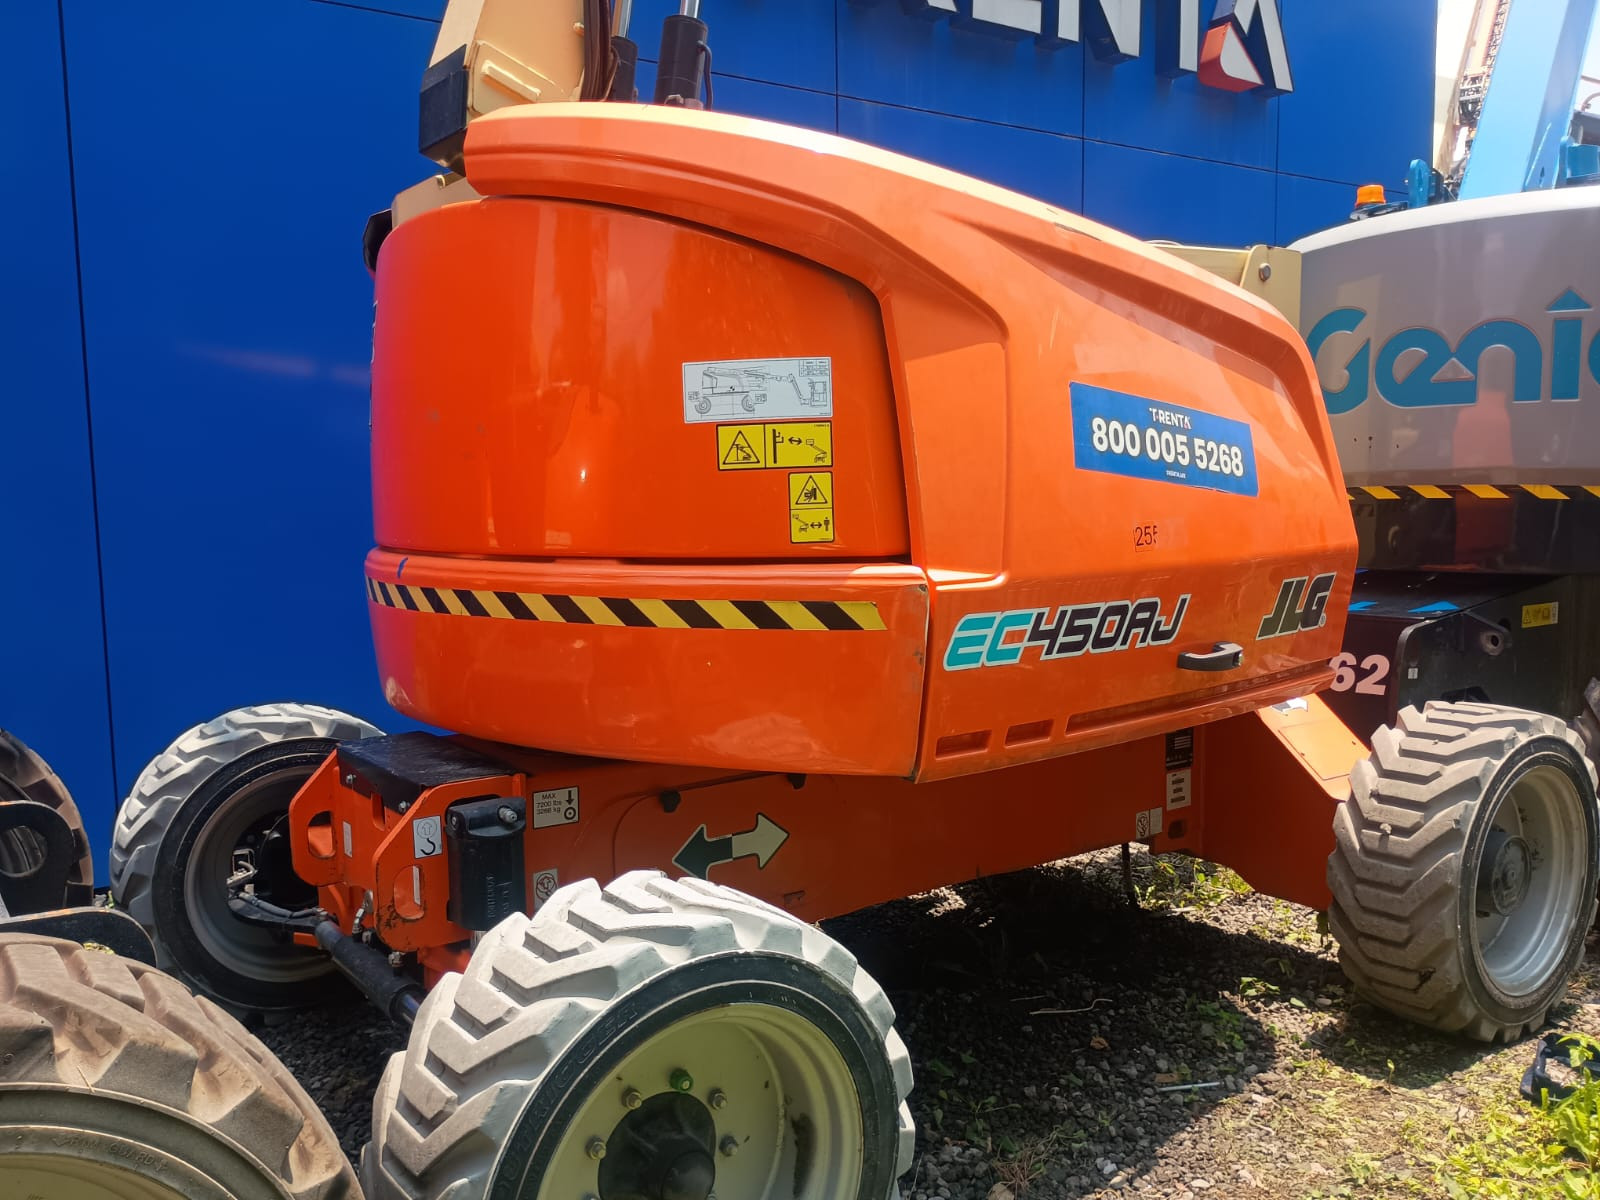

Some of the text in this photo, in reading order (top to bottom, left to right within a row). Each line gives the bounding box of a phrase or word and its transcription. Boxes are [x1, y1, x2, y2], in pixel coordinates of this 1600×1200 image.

[1307, 286, 1600, 414] Geni
[1091, 417, 1244, 478] 800 005 5268
[943, 594, 1192, 671] EC450AJ
[1256, 572, 1337, 640] JLG
